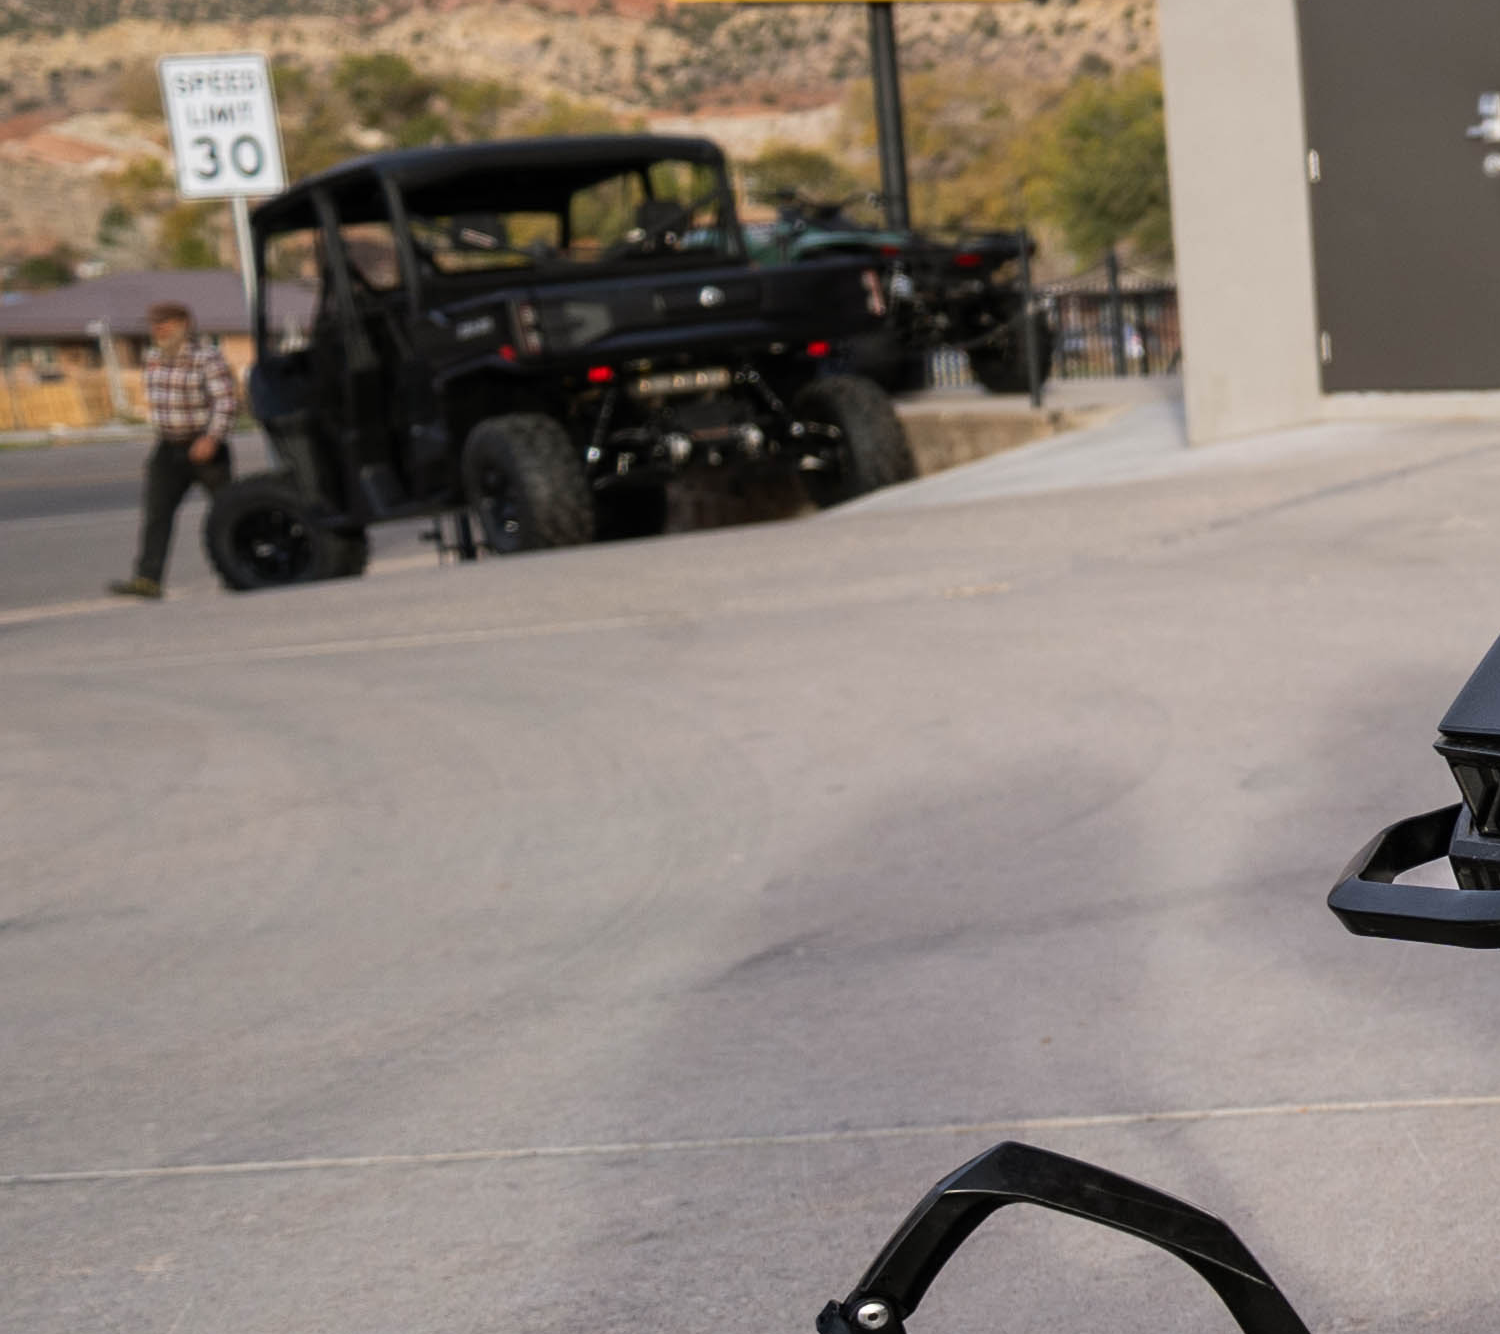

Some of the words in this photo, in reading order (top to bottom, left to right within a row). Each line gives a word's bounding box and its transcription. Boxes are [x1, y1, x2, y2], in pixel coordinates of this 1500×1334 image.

[175, 69, 258, 98] SPEED
[185, 99, 252, 127] LIMIT
[191, 134, 264, 180] 30
